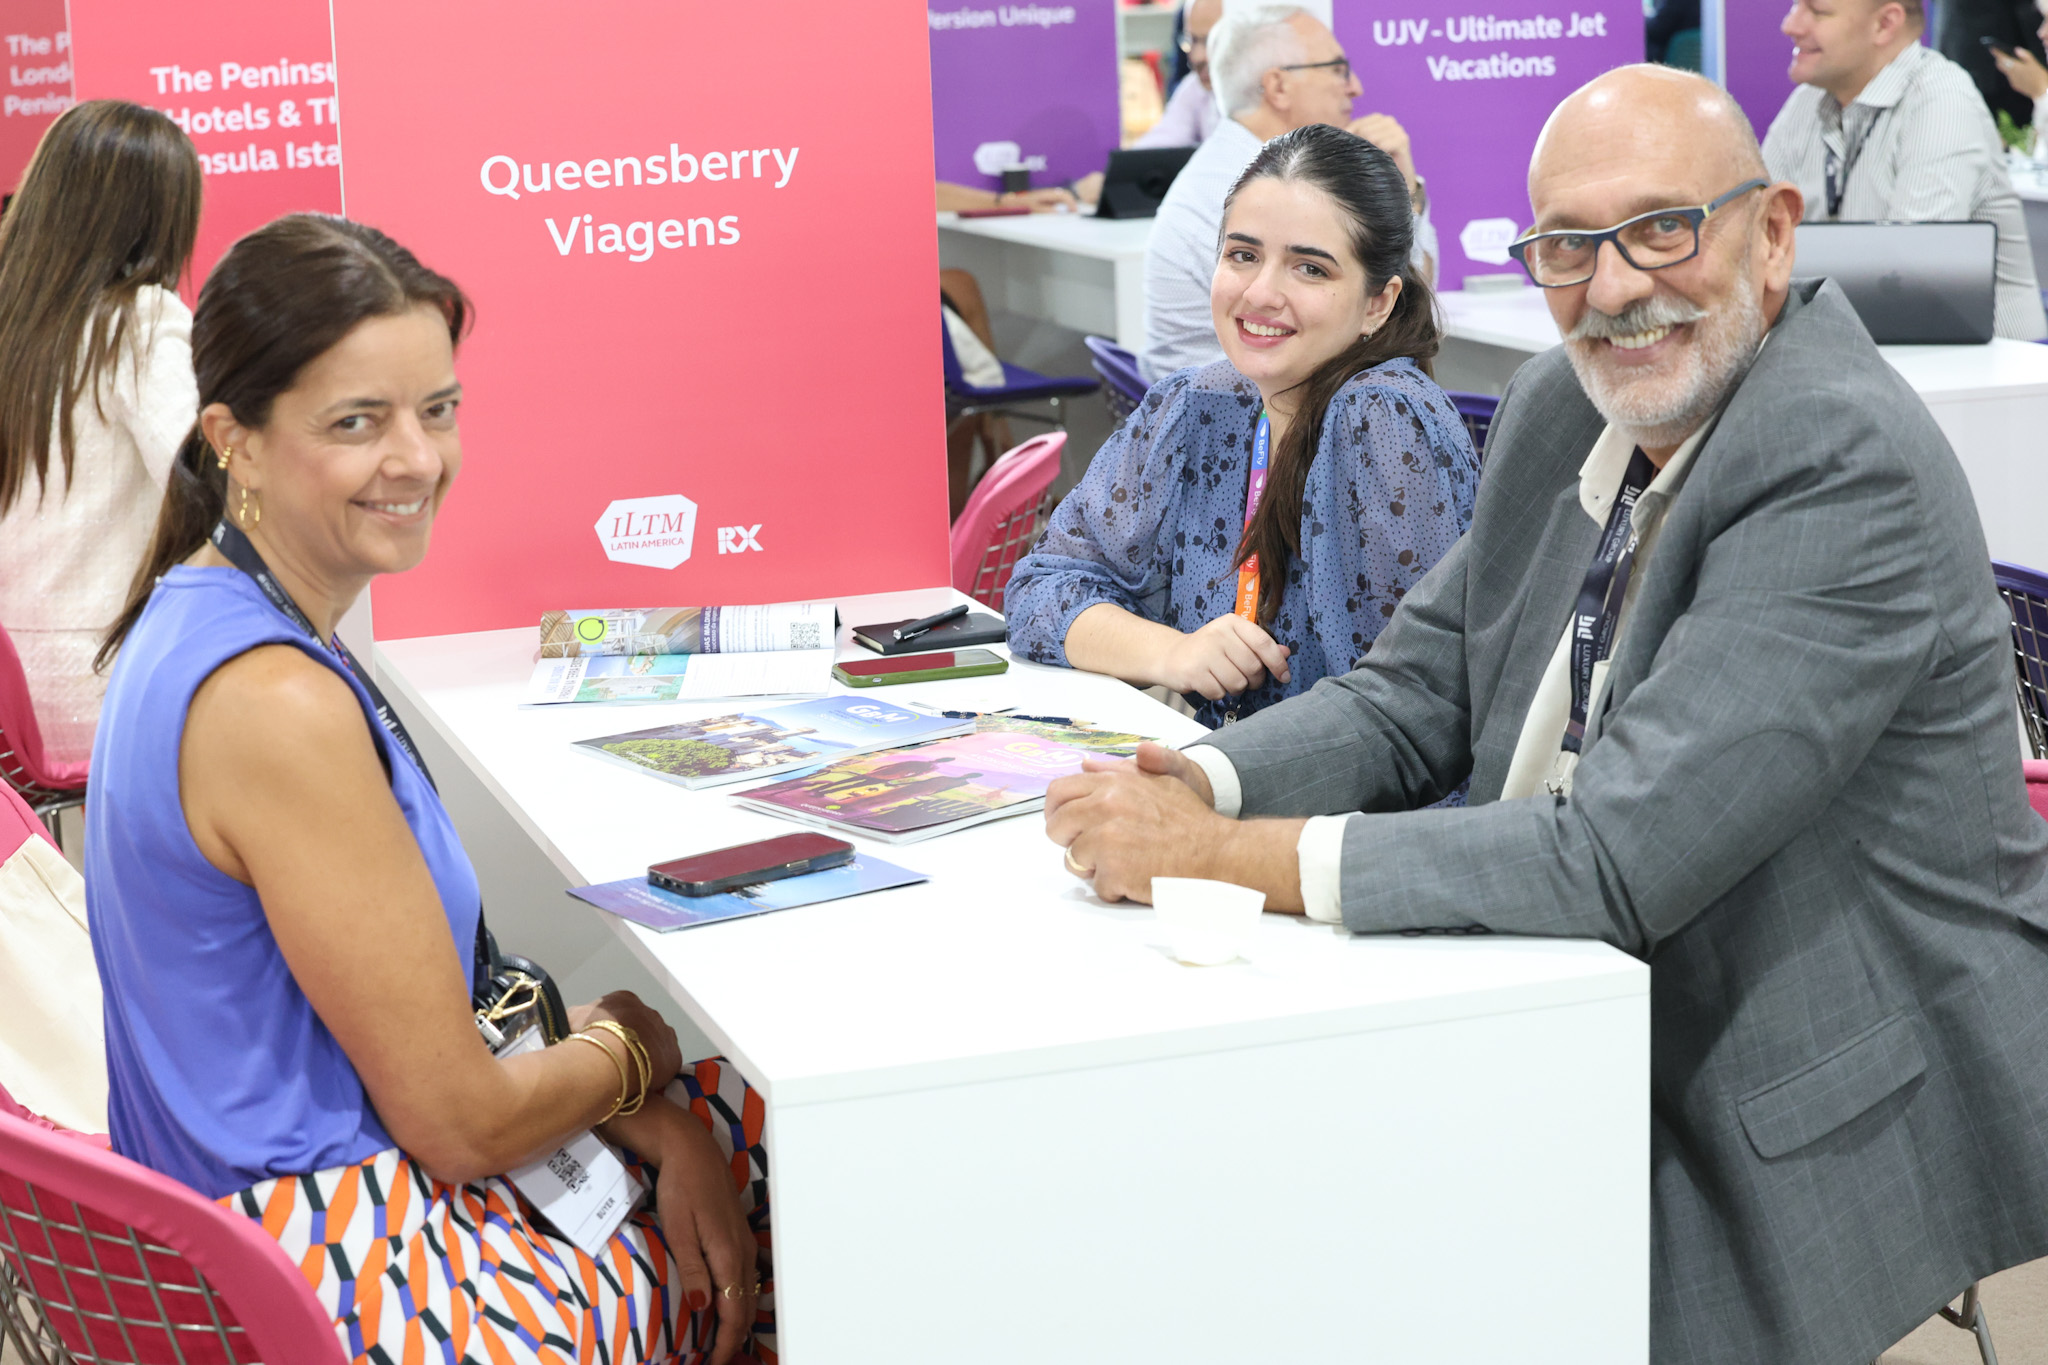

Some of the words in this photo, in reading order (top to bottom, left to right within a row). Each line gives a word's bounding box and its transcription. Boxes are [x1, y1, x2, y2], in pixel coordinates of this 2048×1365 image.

[999, 3, 1076, 28] Unique
[1373, 18, 1429, 46] UJV
[1445, 14, 1563, 43] Ultimate
[1565, 12, 1608, 38] Jet
[5, 32, 51, 56] The
[150, 65, 213, 94] The
[1426, 51, 1556, 81] Vacations
[278, 100, 301, 127] &
[479, 142, 800, 201] Queensberry
[544, 213, 741, 262] Viagens
[1256, 439, 1265, 466] BeFly
[610, 540, 640, 552] LATIN
[640, 537, 685, 550] AMERICA
[717, 523, 764, 555] RX
[1582, 643, 1592, 679] LUXURY
[596, 1196, 616, 1220] BUYER
